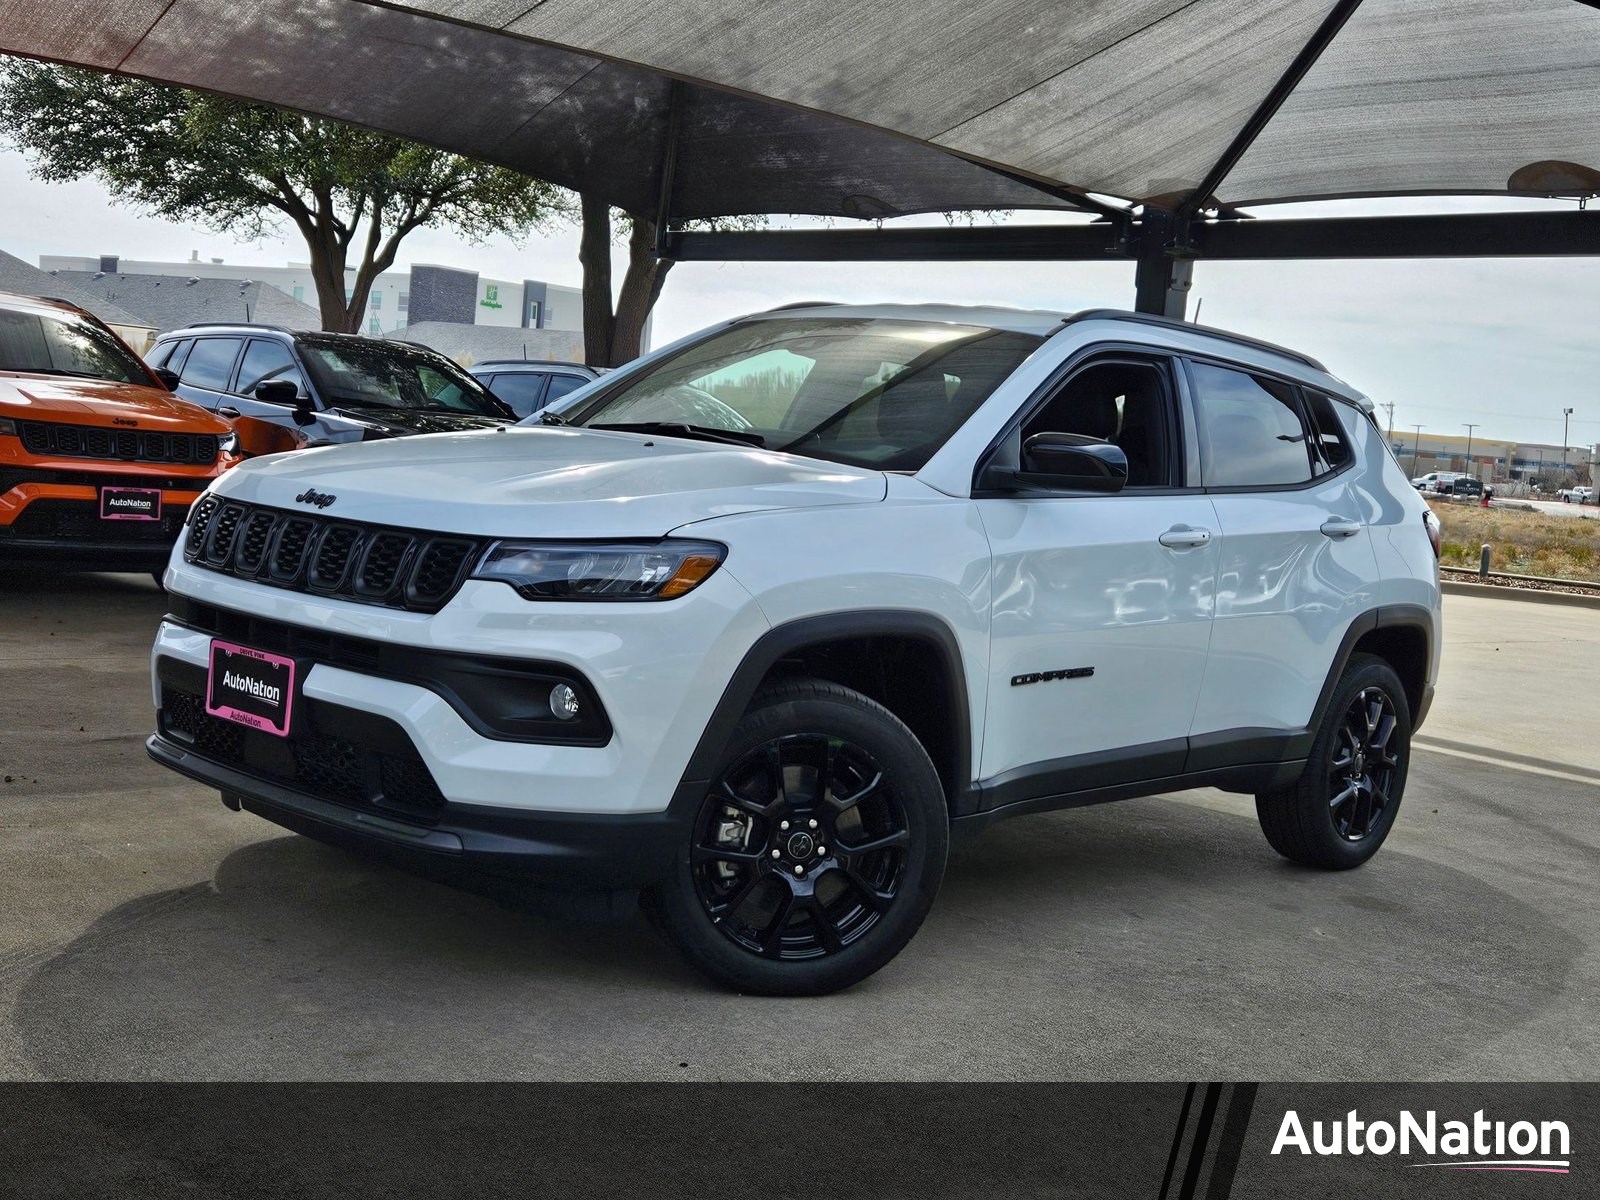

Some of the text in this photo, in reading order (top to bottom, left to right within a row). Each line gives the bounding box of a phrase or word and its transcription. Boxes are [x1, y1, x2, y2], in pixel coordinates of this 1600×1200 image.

[112, 418, 138, 427] Jeep
[109, 498, 151, 507] AutoNation
[295, 488, 337, 509] Jeep
[222, 670, 280, 701] AutoNation
[230, 711, 261, 727] AutoNation
